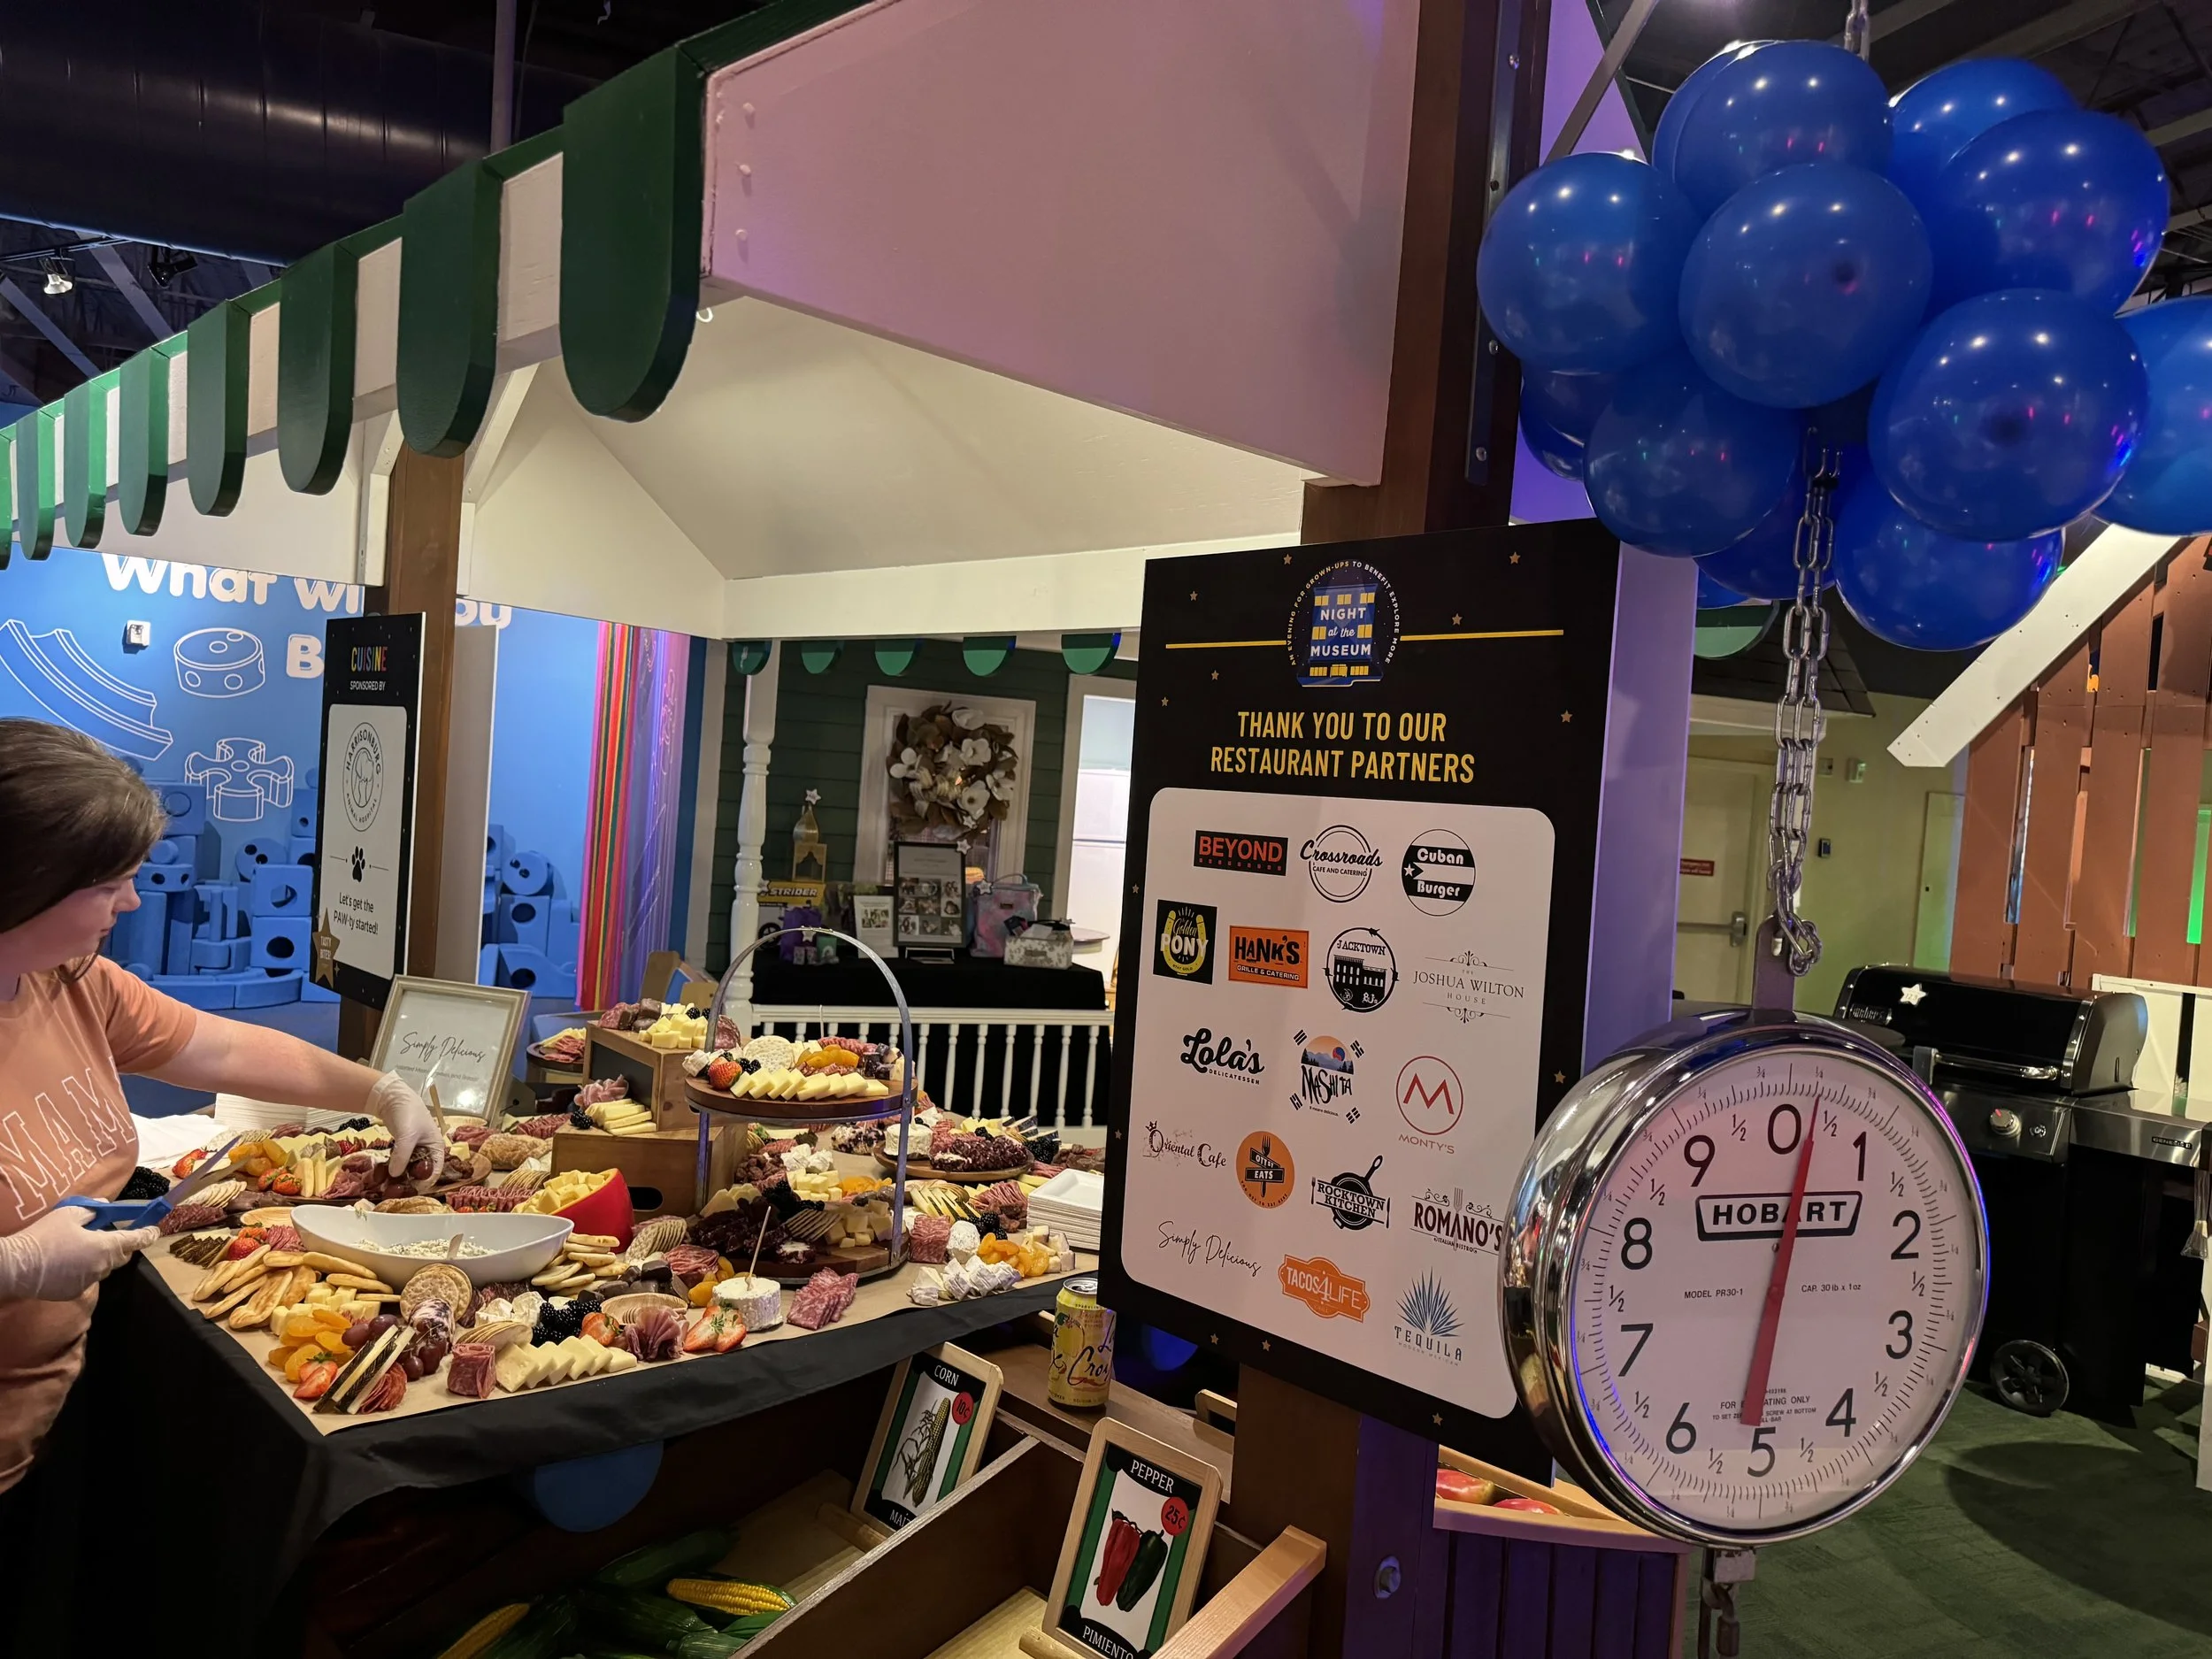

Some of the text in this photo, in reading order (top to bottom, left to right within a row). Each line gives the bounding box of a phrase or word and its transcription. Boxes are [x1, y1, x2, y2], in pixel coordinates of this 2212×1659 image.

[1306, 561, 1349, 589] GROWN-UPS
[1364, 564, 1392, 589] BENEFIT
[1294, 590, 1306, 608] FOR
[1320, 607, 1366, 620] NIGHT
[1389, 591, 1400, 634] EXPLORE
[1286, 611, 1296, 651] EVENING
[1328, 626, 1355, 637] at the
[351, 646, 388, 672] CUISINE
[1289, 654, 1296, 665] AN
[1310, 644, 1371, 657] MUSEUM
[1385, 637, 1398, 664] MORE
[349, 680, 386, 691] SPONSORED BY
[1238, 711, 1447, 741] THANK YOU TO OUR
[346, 729, 381, 775] HARRISONBURG
[1210, 746, 1475, 784] RESTAURANT PARTNERS
[1198, 835, 1283, 864] BEYOND
[1300, 839, 1384, 868] Crossroads
[1417, 848, 1464, 865] Cuban
[1340, 867, 1368, 877] CATERING
[770, 887, 818, 896] STRIDER
[1417, 880, 1461, 898] Burger
[339, 892, 374, 913] Let's get the
[356, 918, 379, 934] started!
[1172, 918, 1198, 937] Golden
[1160, 933, 1210, 957] PONY
[1234, 935, 1300, 965] HANK'S
[1336, 940, 1386, 956] JACKTOWN
[1236, 964, 1258, 974] GRILLE
[1266, 969, 1300, 981] CATERING
[1413, 971, 1525, 999] JOSHUA WILTON
[1447, 992, 1486, 1005] HOUSE
[400, 1032, 486, 1063] Simply Delicious
[1180, 1027, 1265, 1075] Lola's
[1209, 1068, 1261, 1085] DELICATESSEN
[0, 1056, 136, 1221] MAM
[1767, 1103, 1801, 1155] 0
[1149, 1129, 1194, 1157] Oriental
[1197, 1143, 1226, 1168] Cafe
[1398, 1133, 1455, 1155] MONTY'S
[1853, 1131, 1867, 1181] 1
[1684, 1135, 1715, 1187] 9
[1255, 1171, 1273, 1179] EATS
[1317, 1183, 1385, 1211] ROCKTOWN
[1324, 1194, 1376, 1218] KITCHEN
[1414, 1202, 1503, 1251] ROMANO'S
[1712, 1202, 1847, 1225] HOBRT
[1438, 1238, 1473, 1252] ITALIAN BISTRO
[1621, 1217, 1653, 1270] 8
[1891, 1210, 1921, 1260] 2
[1158, 1221, 1262, 1277] Simply Delicious
[1684, 1288, 1743, 1299] MODEL PR30-1
[1394, 1326, 1462, 1361] TEQUILA
[1886, 1310, 1913, 1360] 3
[1617, 1323, 1654, 1377] 7
[933, 1364, 960, 1386] CORN
[956, 1398, 971, 1419] 10¢
[1791, 1395, 1810, 1404] ONLY
[1825, 1387, 1856, 1438] 4
[1665, 1402, 1697, 1455] 6
[1747, 1426, 1777, 1478] 5
[1130, 1459, 1174, 1494] PEPPER
[889, 1509, 911, 1527] MAÍ
[1164, 1505, 1187, 1530] 25¢
[1082, 1625, 1133, 1659] PIMIENTO
